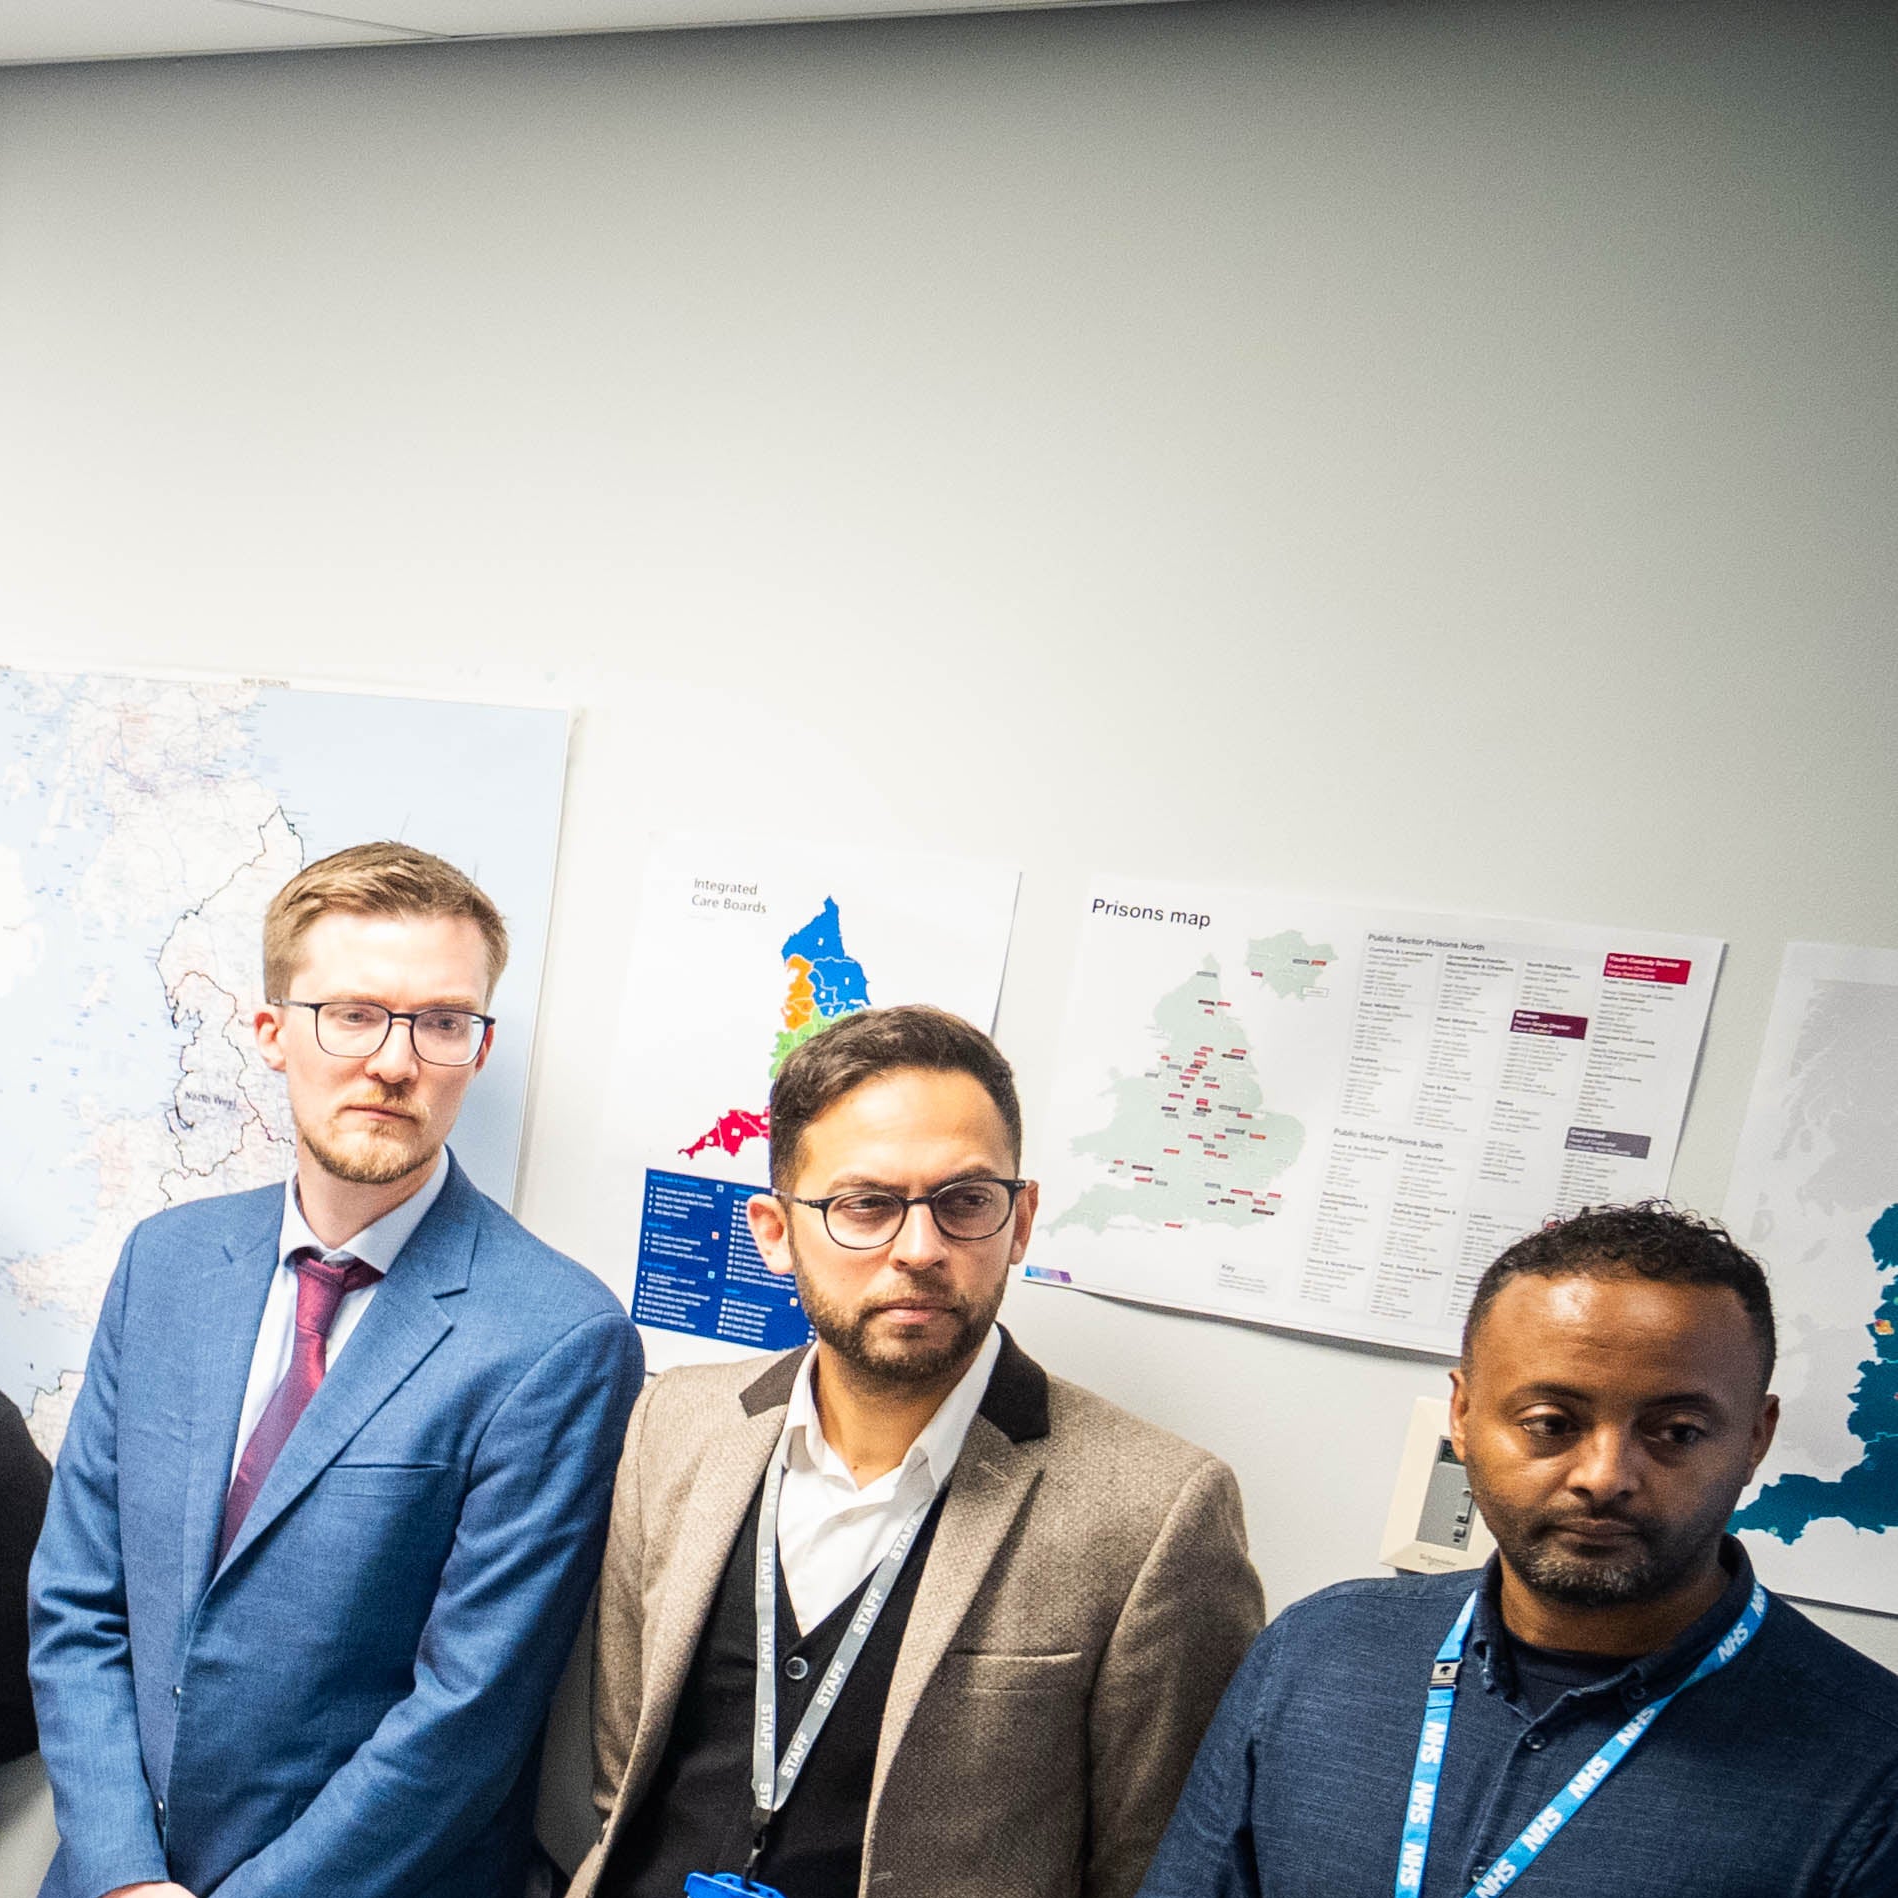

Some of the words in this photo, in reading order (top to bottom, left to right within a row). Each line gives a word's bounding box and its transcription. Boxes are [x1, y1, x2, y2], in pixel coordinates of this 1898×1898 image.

[691, 894, 720, 909] Care
[723, 898, 767, 915] Boards
[694, 878, 758, 896] Integrated
[1091, 897, 1165, 922] Prisons
[1169, 909, 1211, 930] map
[1367, 933, 1394, 944] Public
[1396, 936, 1424, 946] Sector
[1426, 938, 1459, 949] Prisons
[1460, 941, 1485, 951] North
[889, 1514, 919, 1561] STAFF
[760, 1545, 774, 1595] STAFF
[852, 1586, 884, 1637] STAFF
[760, 1624, 773, 1673] STAFF
[1717, 1621, 1749, 1663] NHS
[815, 1659, 847, 1709] STAFF
[760, 1703, 773, 1751] STAFF
[1420, 1721, 1446, 1766] NHS
[1615, 1707, 1656, 1748] NHS
[780, 1731, 810, 1779] STAFF
[1567, 1755, 1610, 1800] NHS
[1408, 1780, 1436, 1826] NHS
[1519, 1805, 1563, 1853] NHS
[1399, 1841, 1424, 1889] NHS
